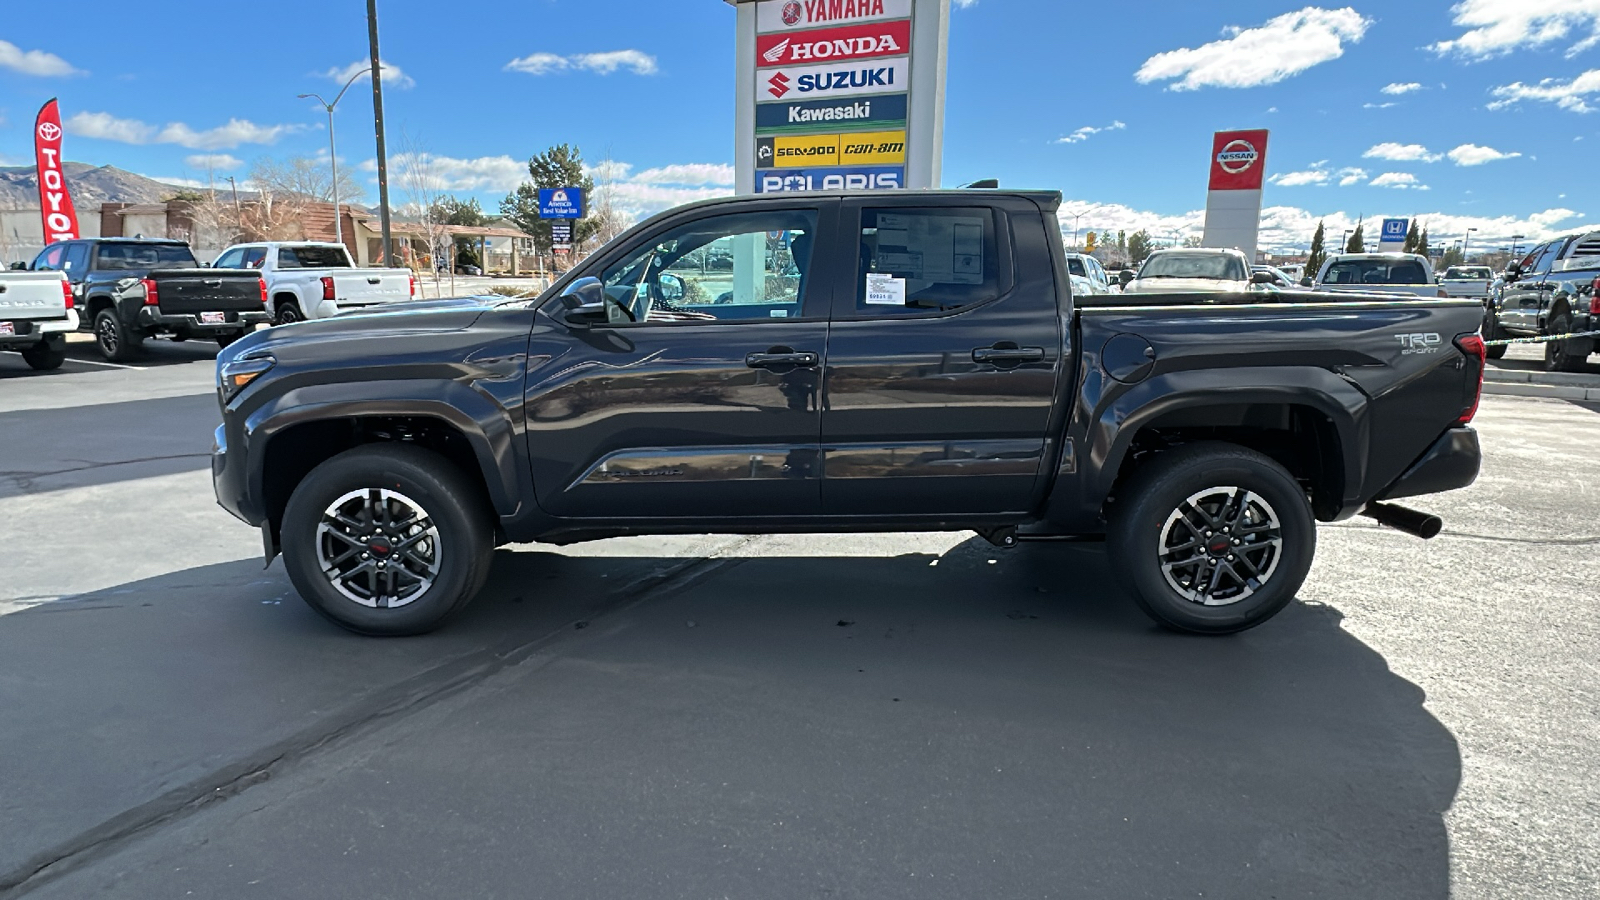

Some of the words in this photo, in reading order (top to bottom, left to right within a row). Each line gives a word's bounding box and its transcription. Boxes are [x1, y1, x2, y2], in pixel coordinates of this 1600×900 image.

[805, 0, 884, 23] YAMAHA
[790, 34, 900, 60] HONDA
[797, 67, 894, 92] SUZUKI
[788, 102, 871, 122] Kawasaki
[844, 142, 904, 154] can-am
[762, 173, 898, 193] POLARIS
[554, 206, 568, 214] Value
[1394, 333, 1441, 347] TRD
